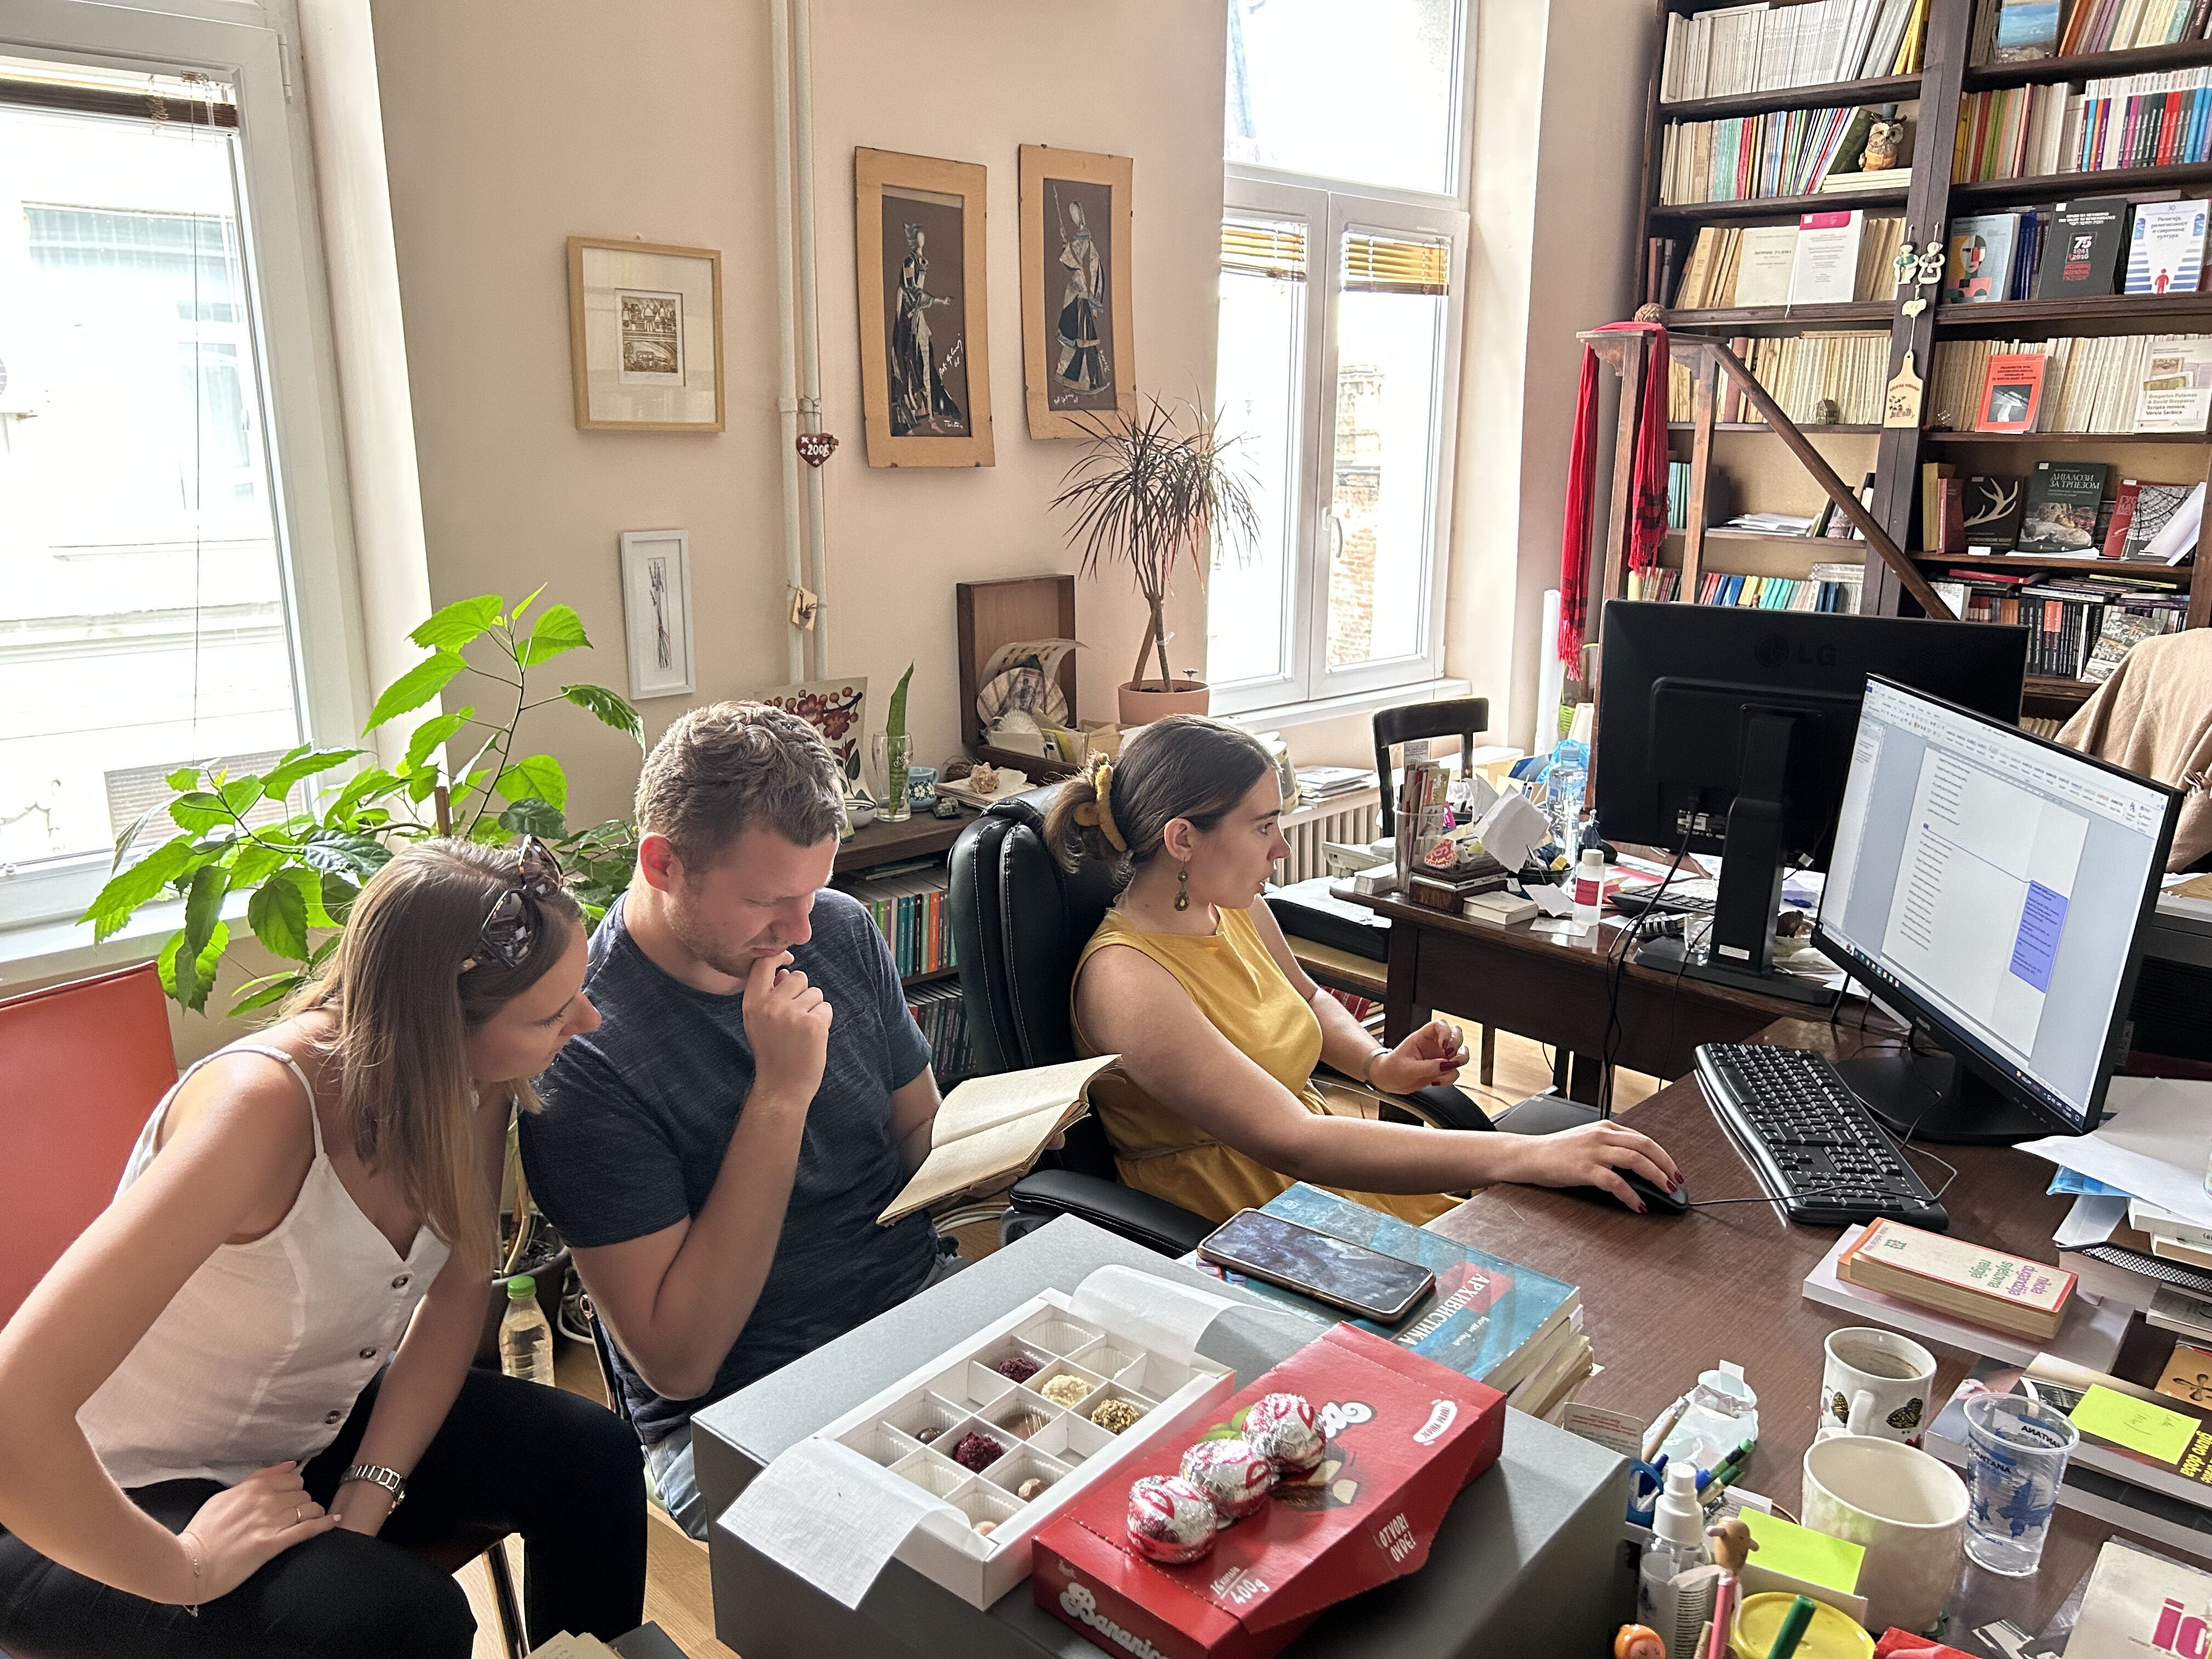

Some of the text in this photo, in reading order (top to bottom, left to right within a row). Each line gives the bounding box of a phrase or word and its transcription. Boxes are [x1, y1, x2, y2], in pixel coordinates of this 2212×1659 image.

[2074, 236, 2092, 249] 75
[2050, 473, 2094, 482] ДИЈАЛОЗИ
[2062, 481, 2100, 489] ТРПЕЗОМ
[1797, 643, 1838, 665] LG
[1968, 1259, 1992, 1279] religija
[1987, 1261, 2014, 1288] svjetovna
[2006, 1265, 2038, 1296] dugandžija
[2030, 1277, 2052, 1294] nikola
[1397, 1273, 1490, 1346] АРХИВИСТИКА
[1468, 1316, 1490, 1333] Богдан
[1421, 1406, 1450, 1438] JEDINA PRAVA!
[2180, 1430, 2212, 1477] gluvo doba
[1379, 1513, 1409, 1548] OTVORI
[1390, 1531, 1417, 1562] OVDE!
[1210, 1578, 1224, 1593] 16
[1230, 1578, 1270, 1605] 400g
[1059, 1582, 1171, 1659] Bananic
